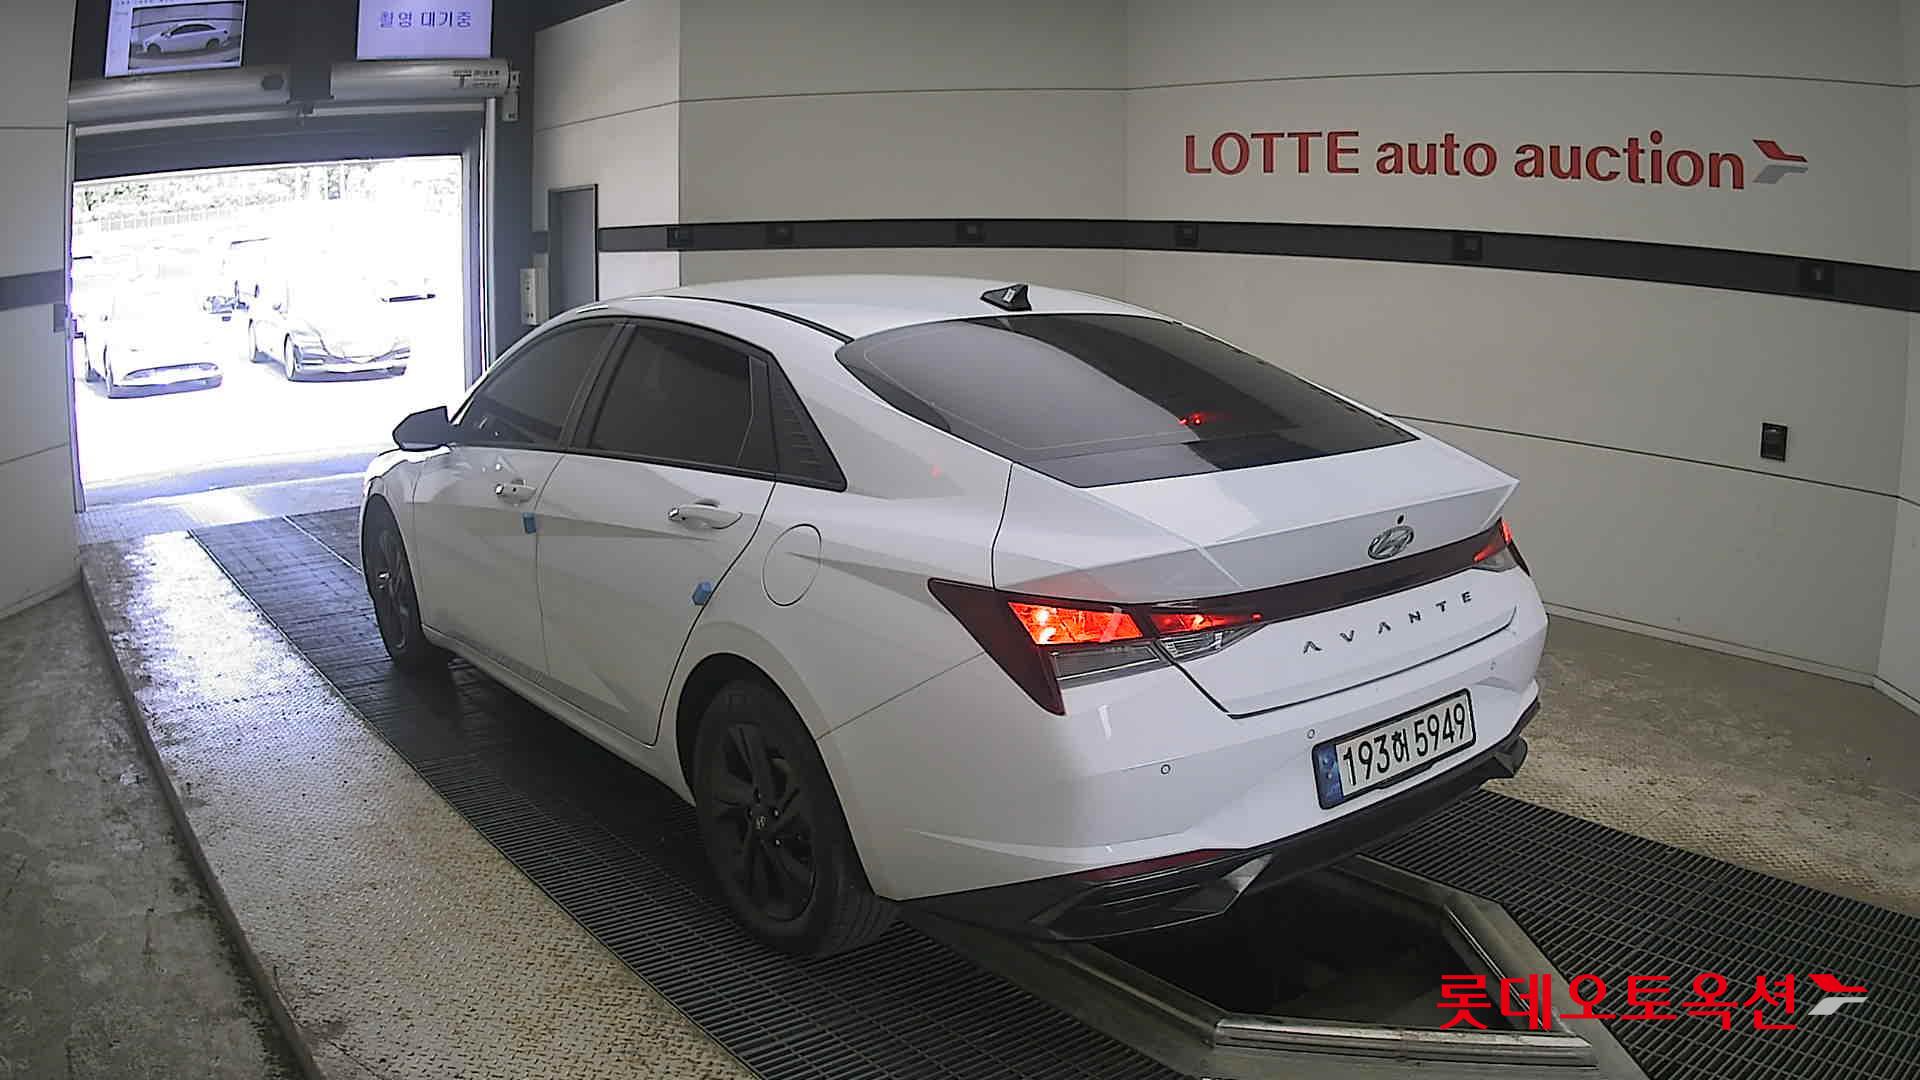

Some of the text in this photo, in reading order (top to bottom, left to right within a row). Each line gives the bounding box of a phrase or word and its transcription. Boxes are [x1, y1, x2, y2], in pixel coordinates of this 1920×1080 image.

[421, 10, 472, 28] 대기중
[1184, 130, 1746, 190] LOTTE auto auction
[1302, 591, 1473, 654] AVANTE
[1414, 703, 1466, 757] 5949
